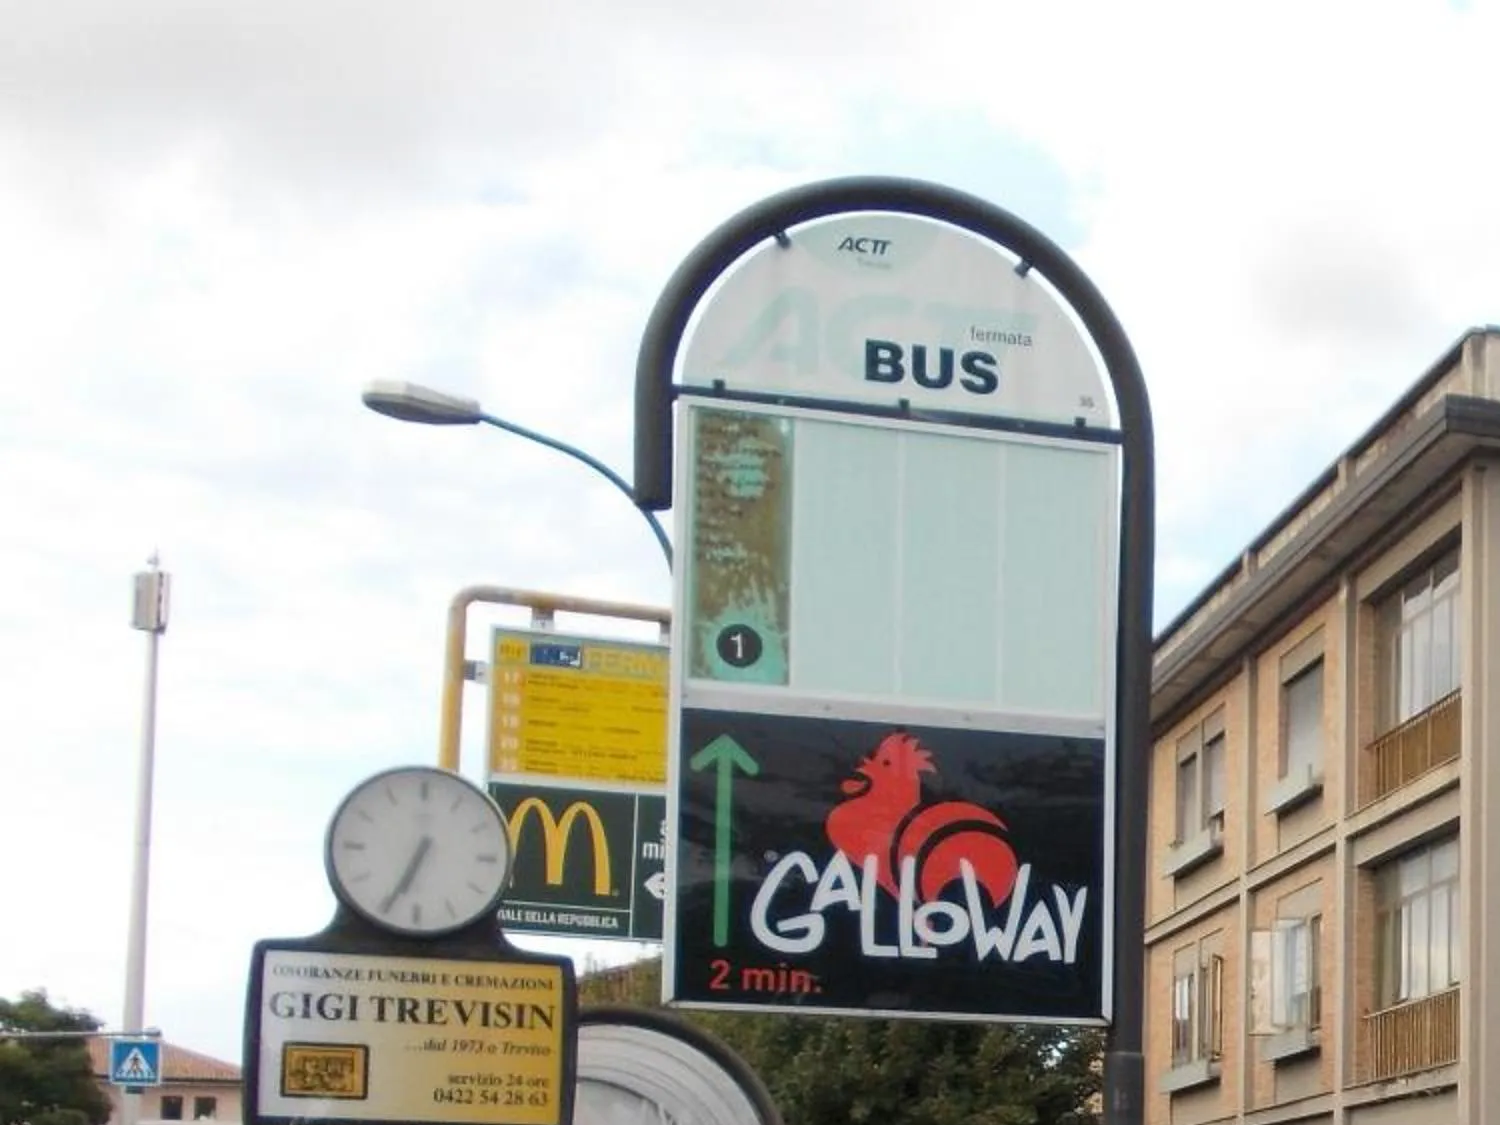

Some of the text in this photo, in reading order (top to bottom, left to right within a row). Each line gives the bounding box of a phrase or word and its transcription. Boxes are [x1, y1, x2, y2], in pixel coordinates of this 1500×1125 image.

[970, 326, 1033, 347] fermata
[864, 337, 999, 395] BUS
[749, 849, 1088, 966] GALLOWAY
[367, 969, 436, 985] FUNEBRI
[441, 971, 449, 985] E
[454, 973, 554, 991] CREMAZIONI
[709, 959, 823, 994] 2 min.
[269, 990, 556, 1031] GIGI TREVISIN
[448, 1072, 550, 1088] servizio 24 ore
[433, 1087, 474, 1105] 0422
[479, 1089, 499, 1105] 54
